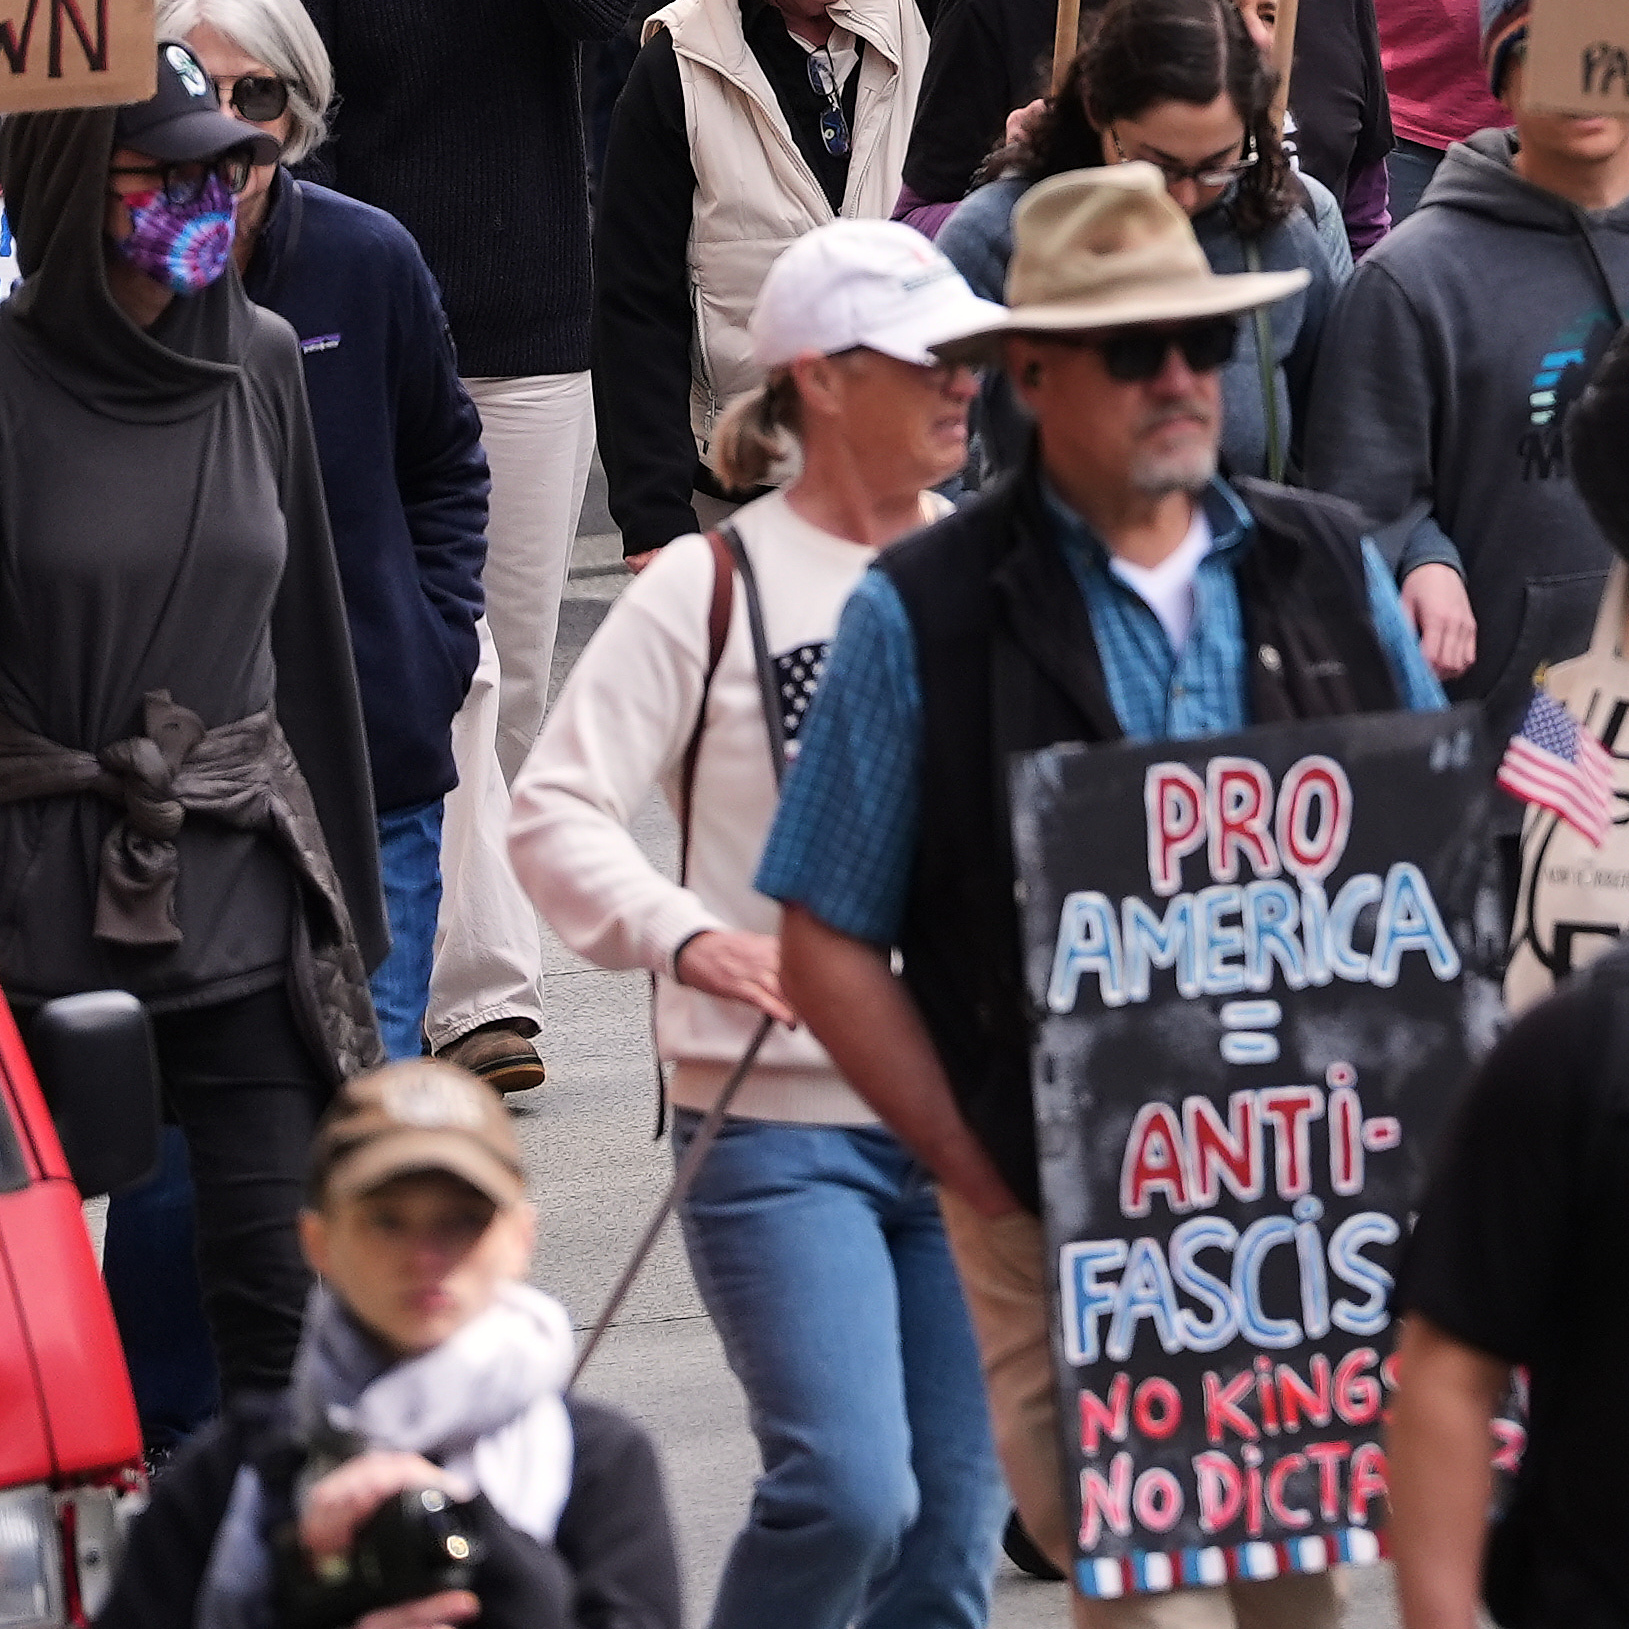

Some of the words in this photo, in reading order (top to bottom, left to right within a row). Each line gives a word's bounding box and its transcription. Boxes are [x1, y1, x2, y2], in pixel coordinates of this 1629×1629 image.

[1143, 754, 1355, 897] PRO
[1077, 1371, 1184, 1460] NO
[1077, 1455, 1184, 1550] NO
